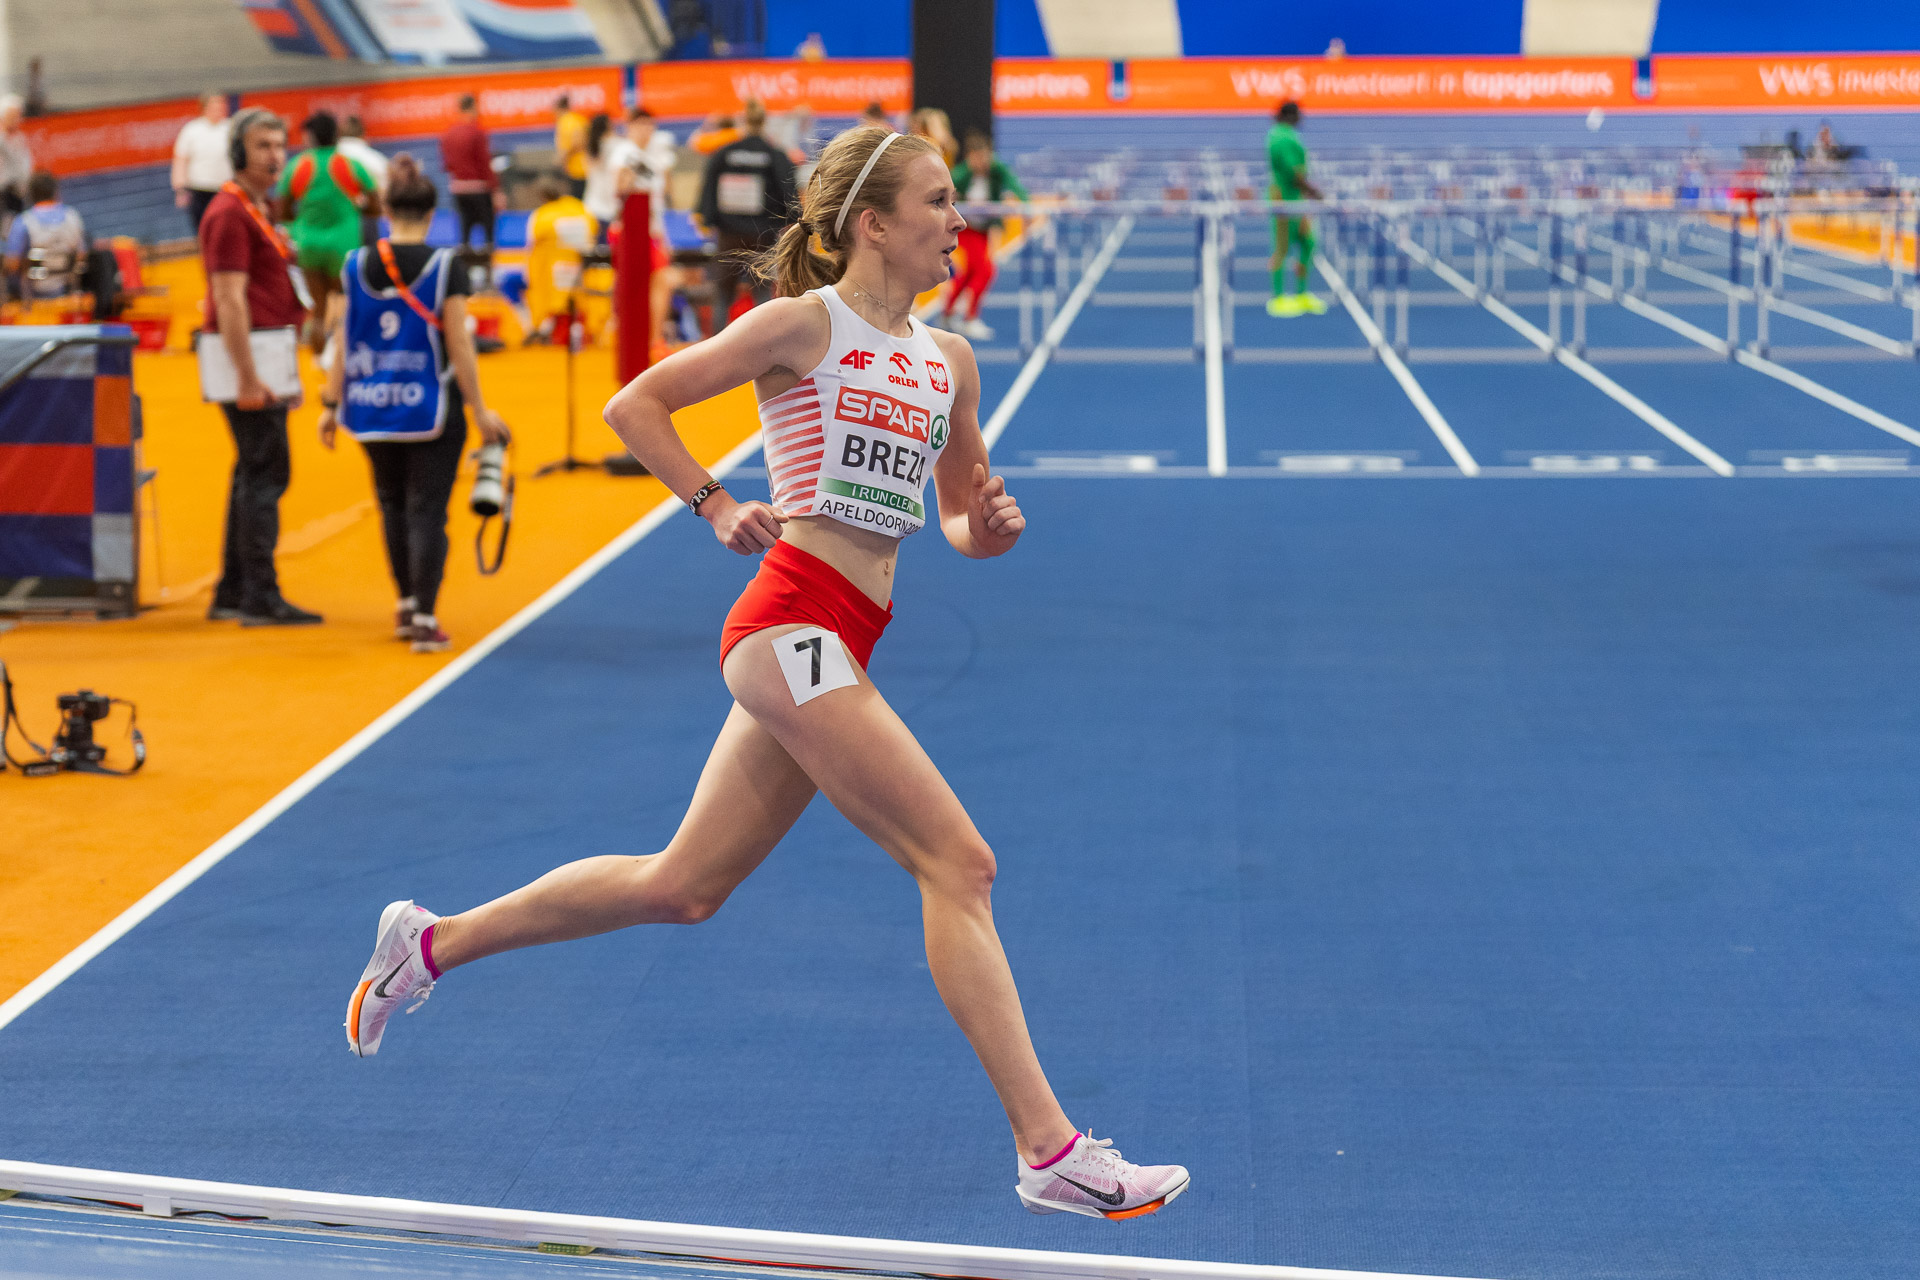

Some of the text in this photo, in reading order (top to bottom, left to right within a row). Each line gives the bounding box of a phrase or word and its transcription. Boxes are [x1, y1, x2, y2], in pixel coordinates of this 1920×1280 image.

[1230, 67, 1306, 98] VWS
[1758, 63, 1834, 97] VWS
[379, 311, 400, 341] 9
[839, 348, 876, 370] 4F
[347, 381, 425, 408] PHOTO
[888, 374, 919, 389] ORLEN
[840, 390, 927, 438] SPAR
[859, 486, 888, 504] RUN
[820, 499, 907, 532] APELDOORN
[794, 636, 822, 688] 7
